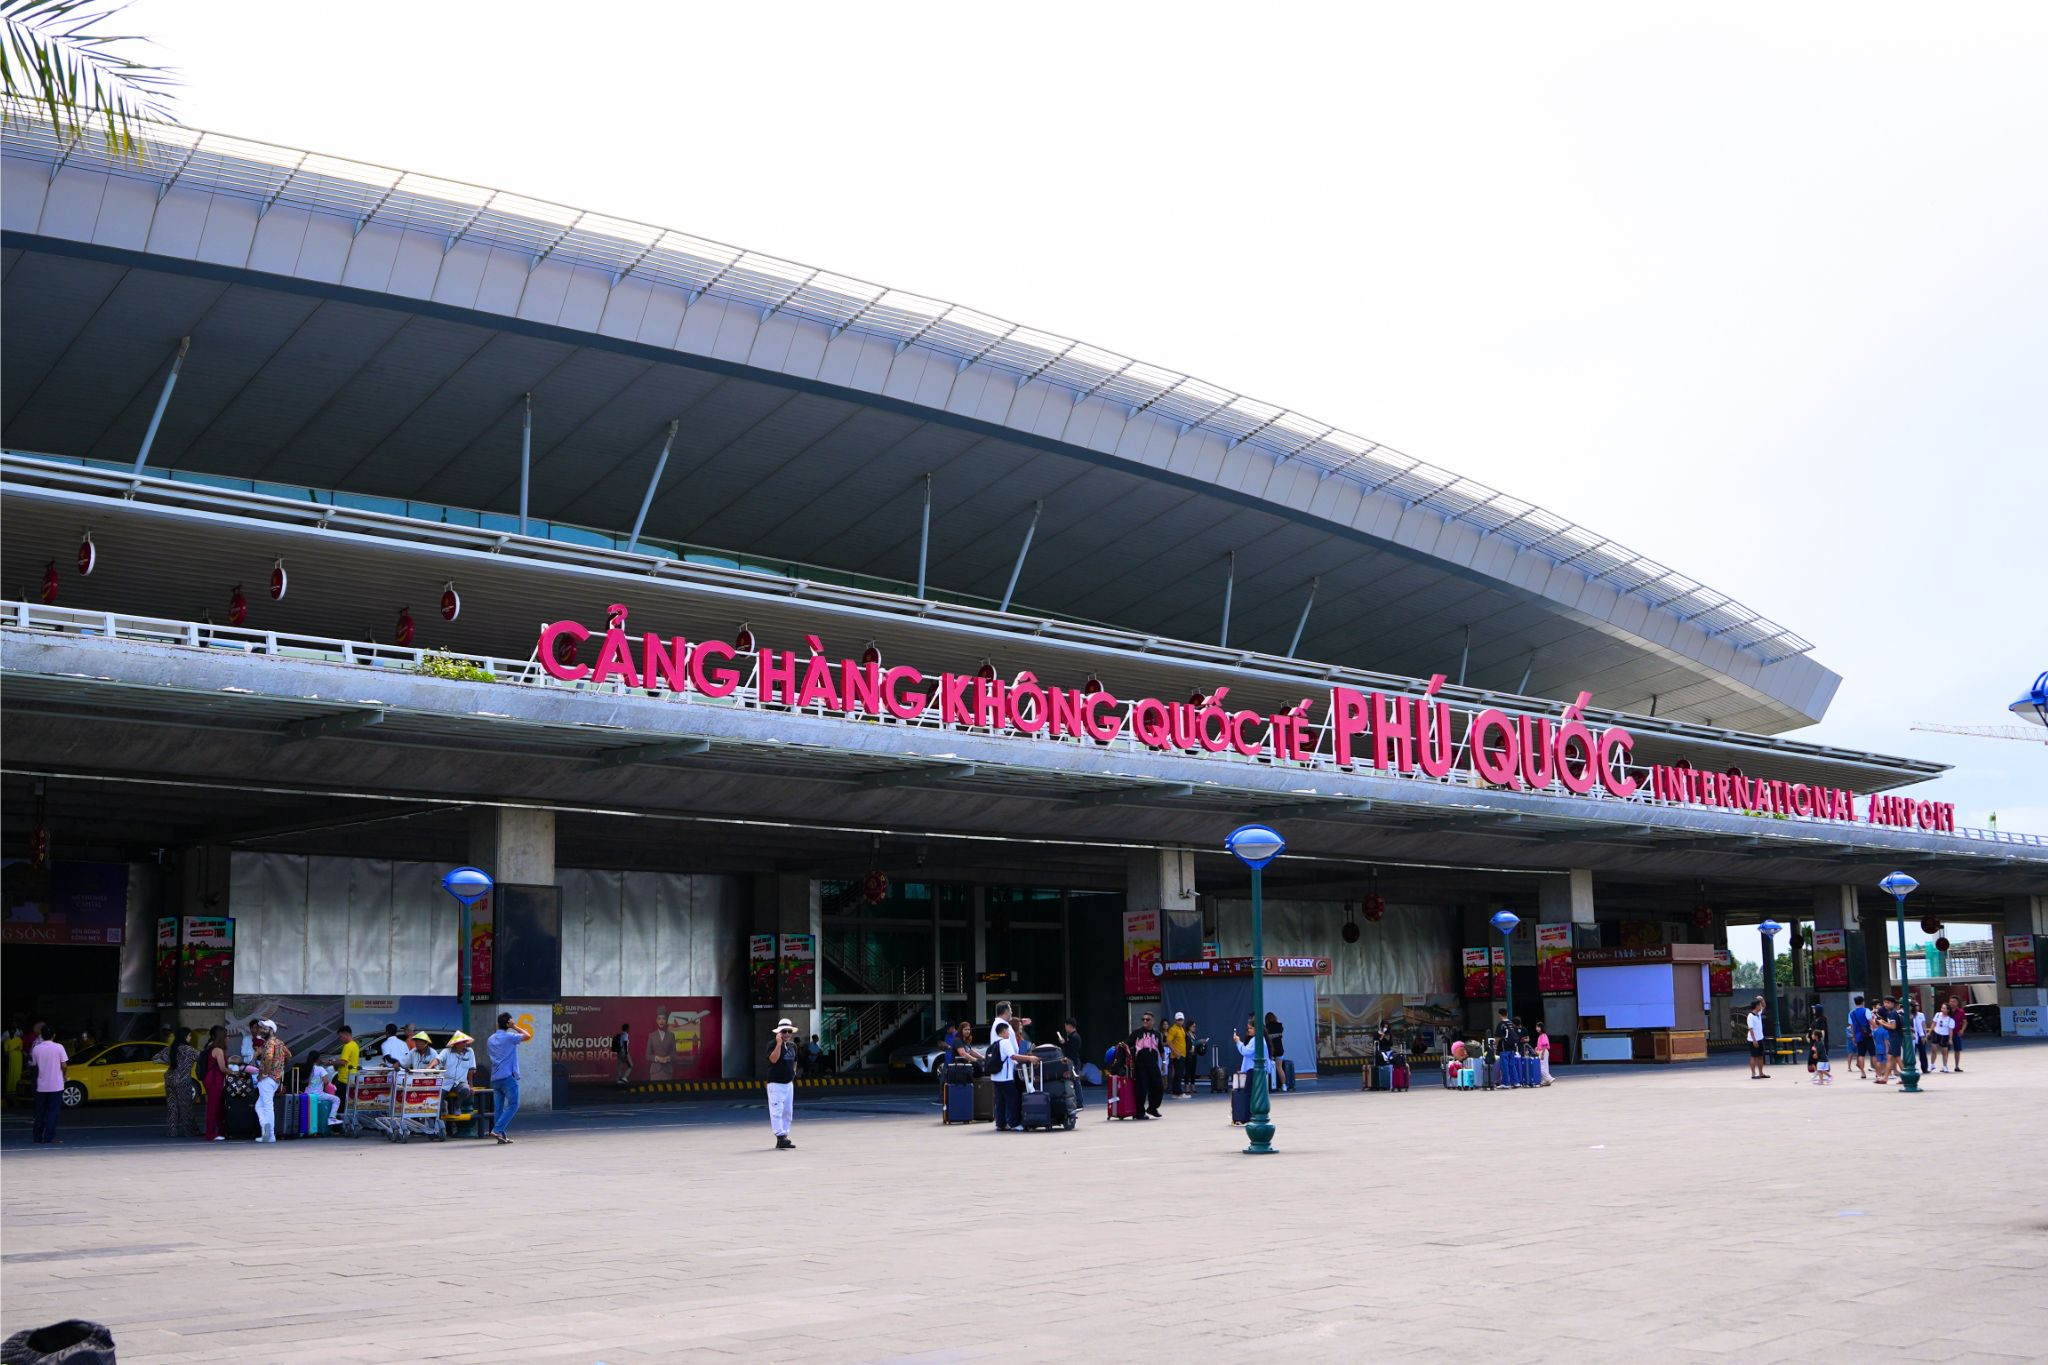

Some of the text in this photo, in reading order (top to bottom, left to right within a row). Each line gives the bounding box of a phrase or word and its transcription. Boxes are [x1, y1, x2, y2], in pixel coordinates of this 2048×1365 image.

[538, 604, 1955, 832] CẢNG HÀNG KHÔNG QUỐC TẾ PHÚ QUỐC INTERNATIONAL AIRPORT
[1644, 947, 1666, 957] Food
[1277, 958, 1314, 967] BAKERY
